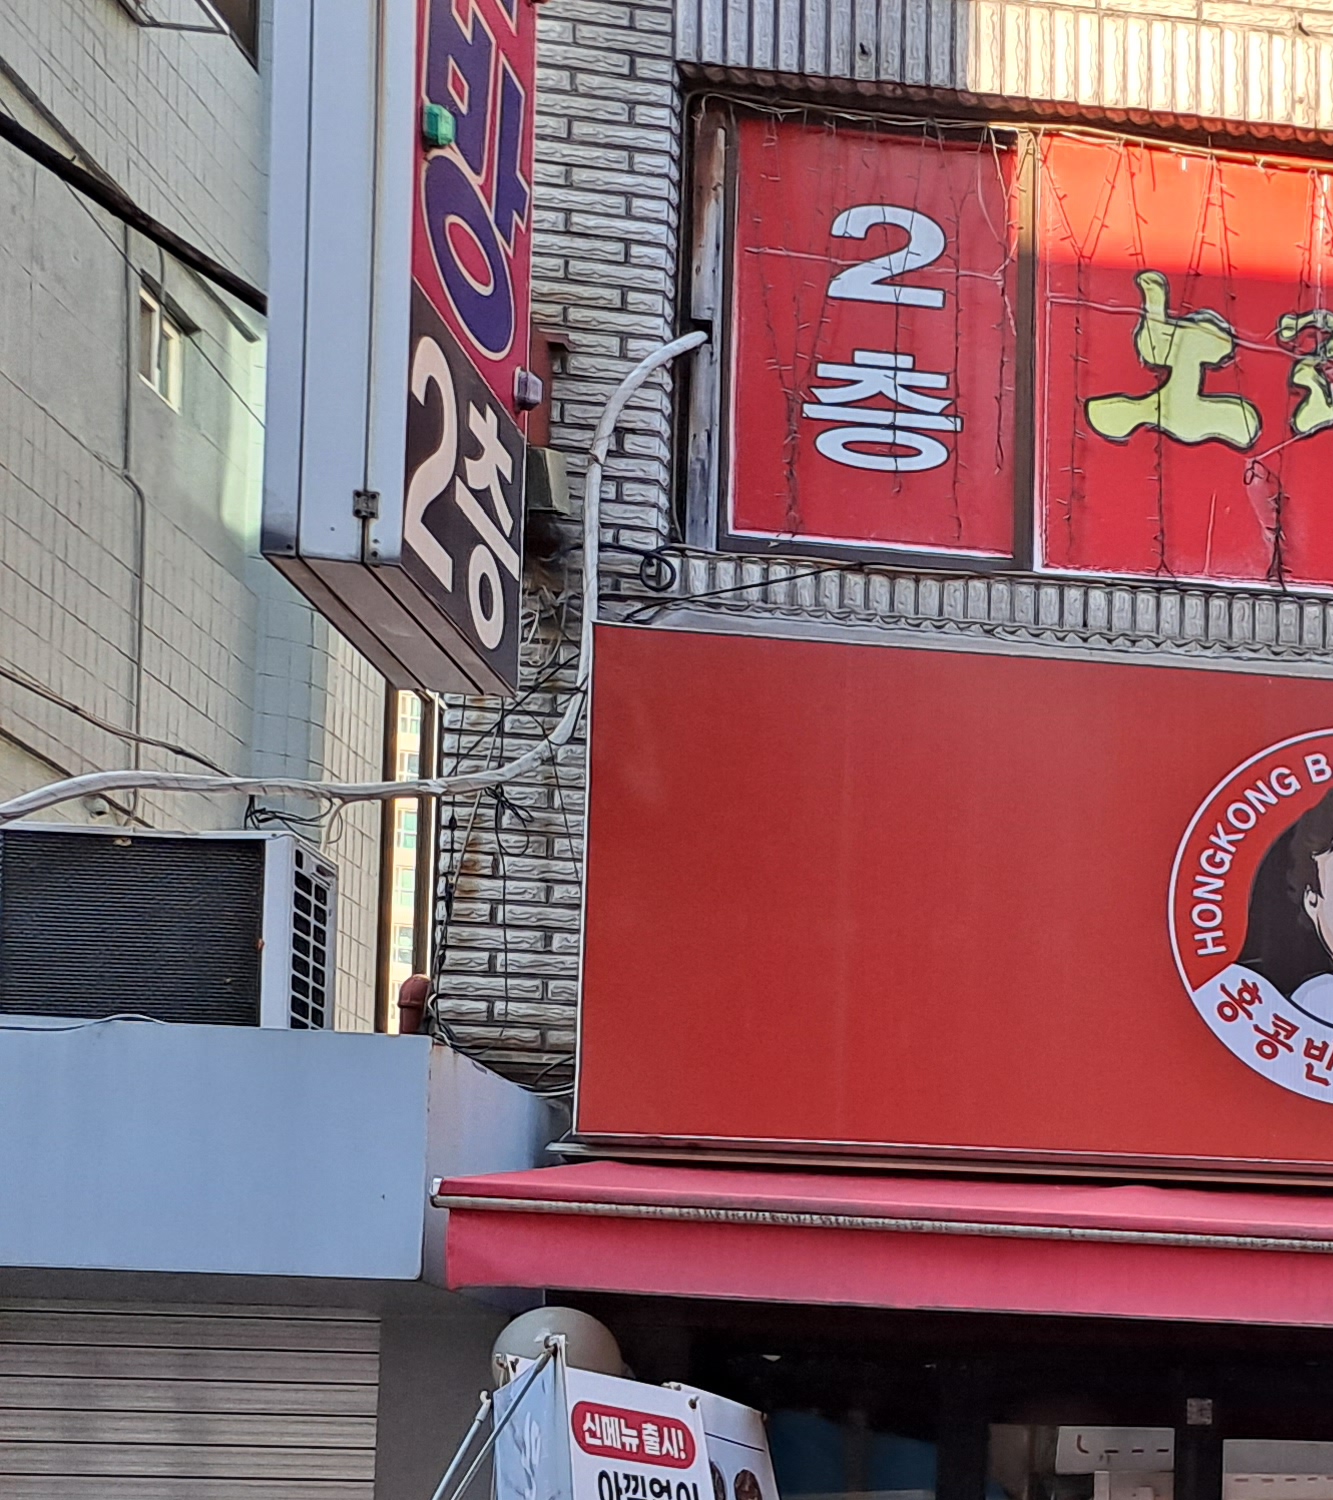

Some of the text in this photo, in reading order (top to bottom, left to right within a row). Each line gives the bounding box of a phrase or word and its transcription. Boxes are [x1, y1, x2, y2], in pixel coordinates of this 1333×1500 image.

[420, 0, 532, 361] 방
[802, 204, 963, 473] 2층
[403, 335, 521, 651] 2층
[1190, 767, 1304, 958] HONGKONG
[582, 1412, 688, 1460] 신메뉴 출시!
